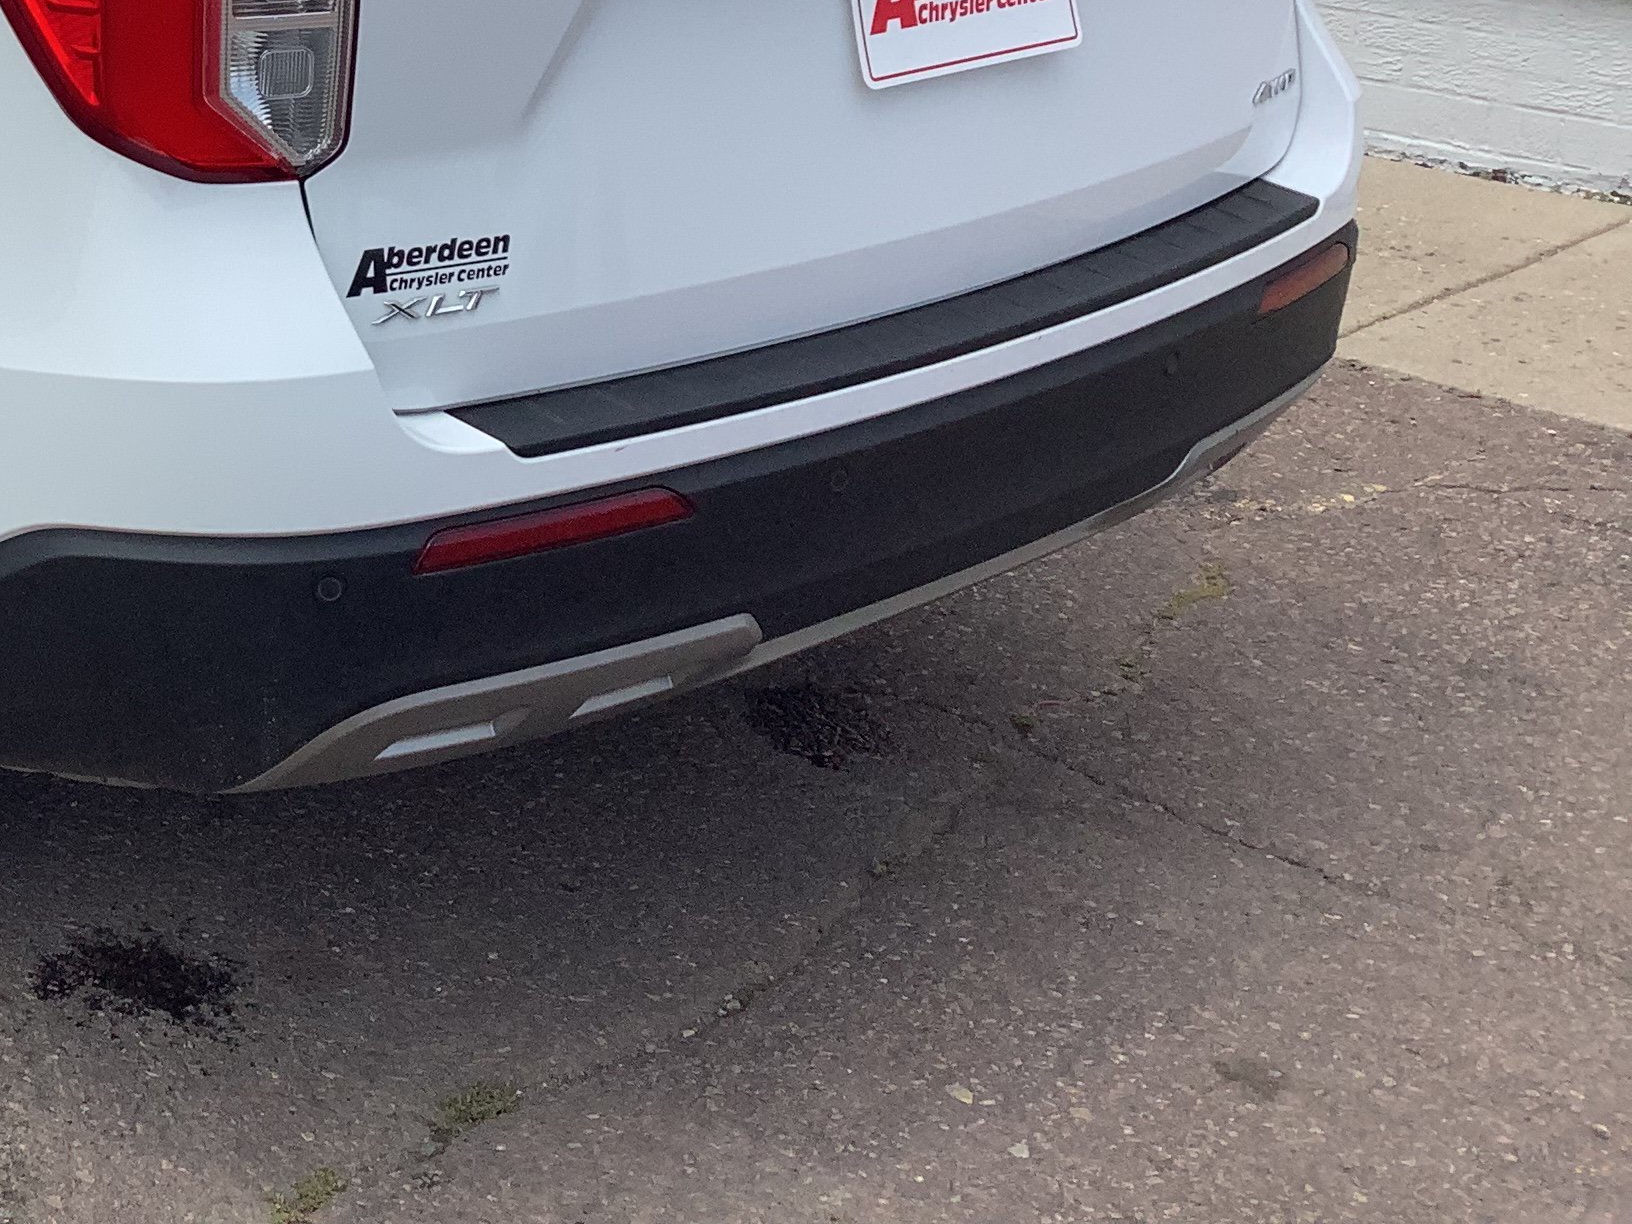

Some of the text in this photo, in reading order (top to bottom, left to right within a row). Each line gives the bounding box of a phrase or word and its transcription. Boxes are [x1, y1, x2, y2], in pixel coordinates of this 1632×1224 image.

[346, 234, 511, 298] Aberdeen
[389, 263, 510, 292] Chrysler Center
[371, 285, 500, 326] XLT
